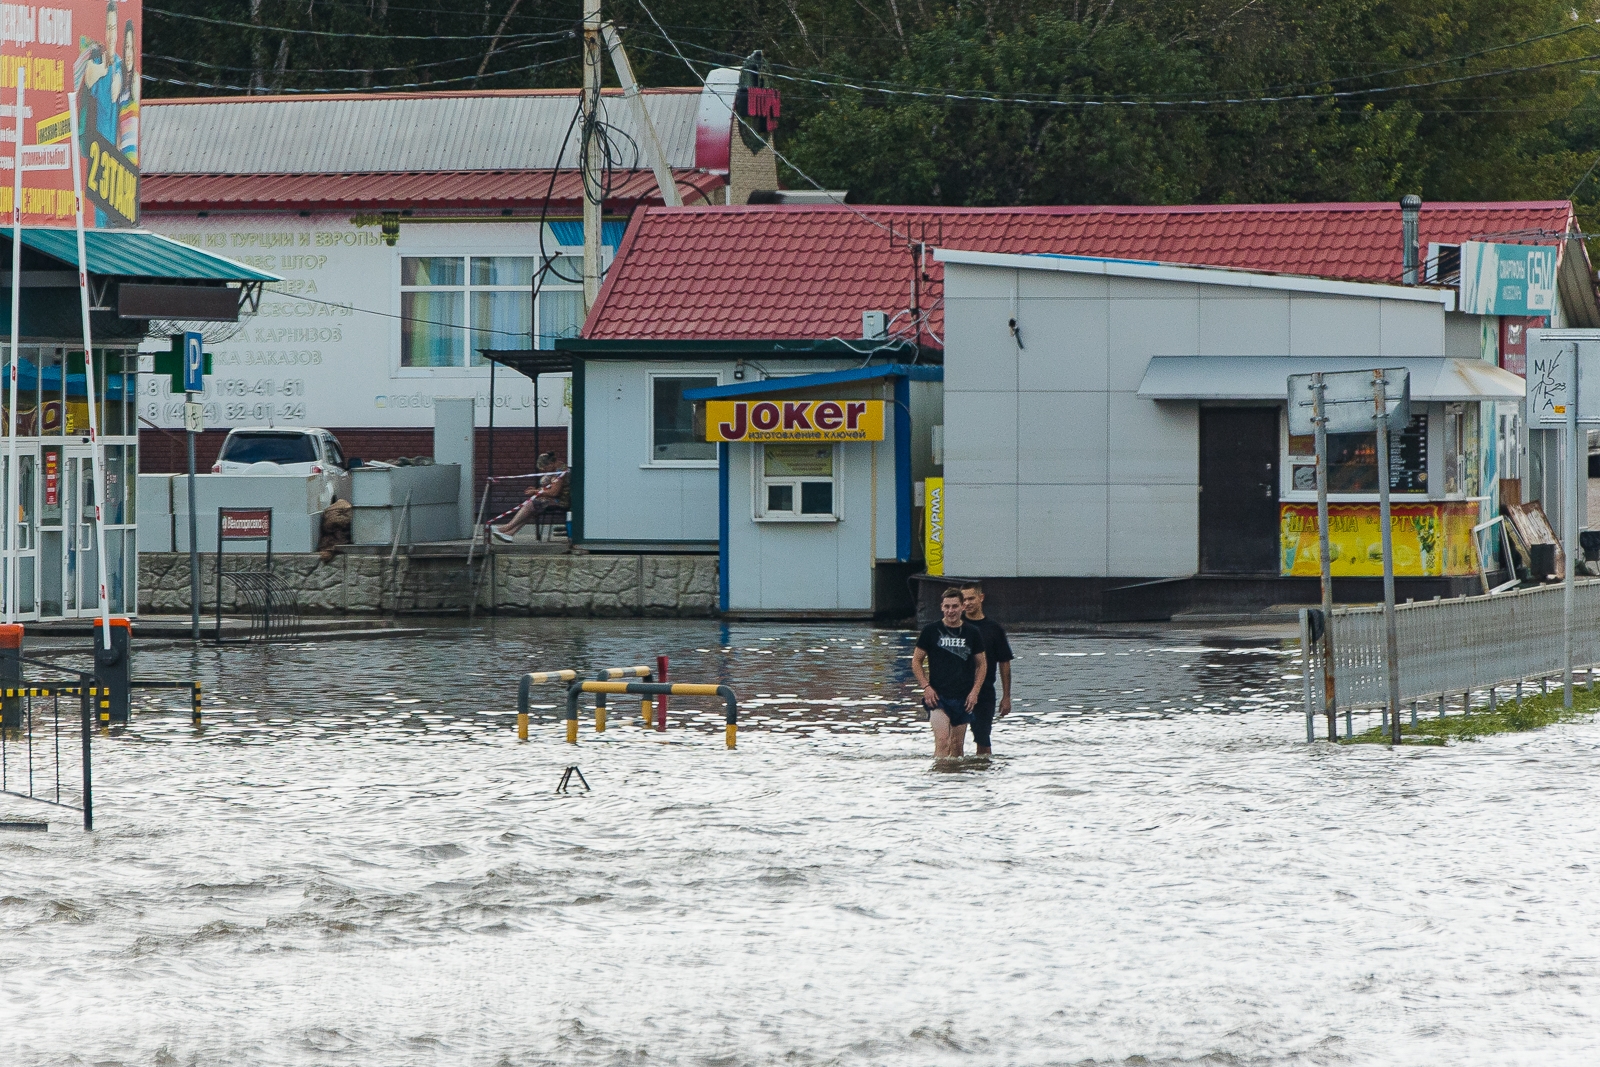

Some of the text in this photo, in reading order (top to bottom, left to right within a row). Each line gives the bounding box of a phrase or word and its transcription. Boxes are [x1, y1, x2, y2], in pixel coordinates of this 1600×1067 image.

[88, 141, 137, 223] 2 ЭТАЖ
[205, 232, 226, 247] ИЗ
[230, 232, 294, 248] ТУРЦИИ
[299, 232, 310, 246] И
[281, 255, 327, 269] ШТОР
[1527, 251, 1552, 291] GSM
[255, 327, 343, 343] КАРНИЗОВ
[189, 338, 200, 384] P
[245, 350, 323, 366] ЗАКАЗОВ
[929, 487, 944, 567] ШАУРМА
[1288, 514, 1359, 533] ШАРМА
